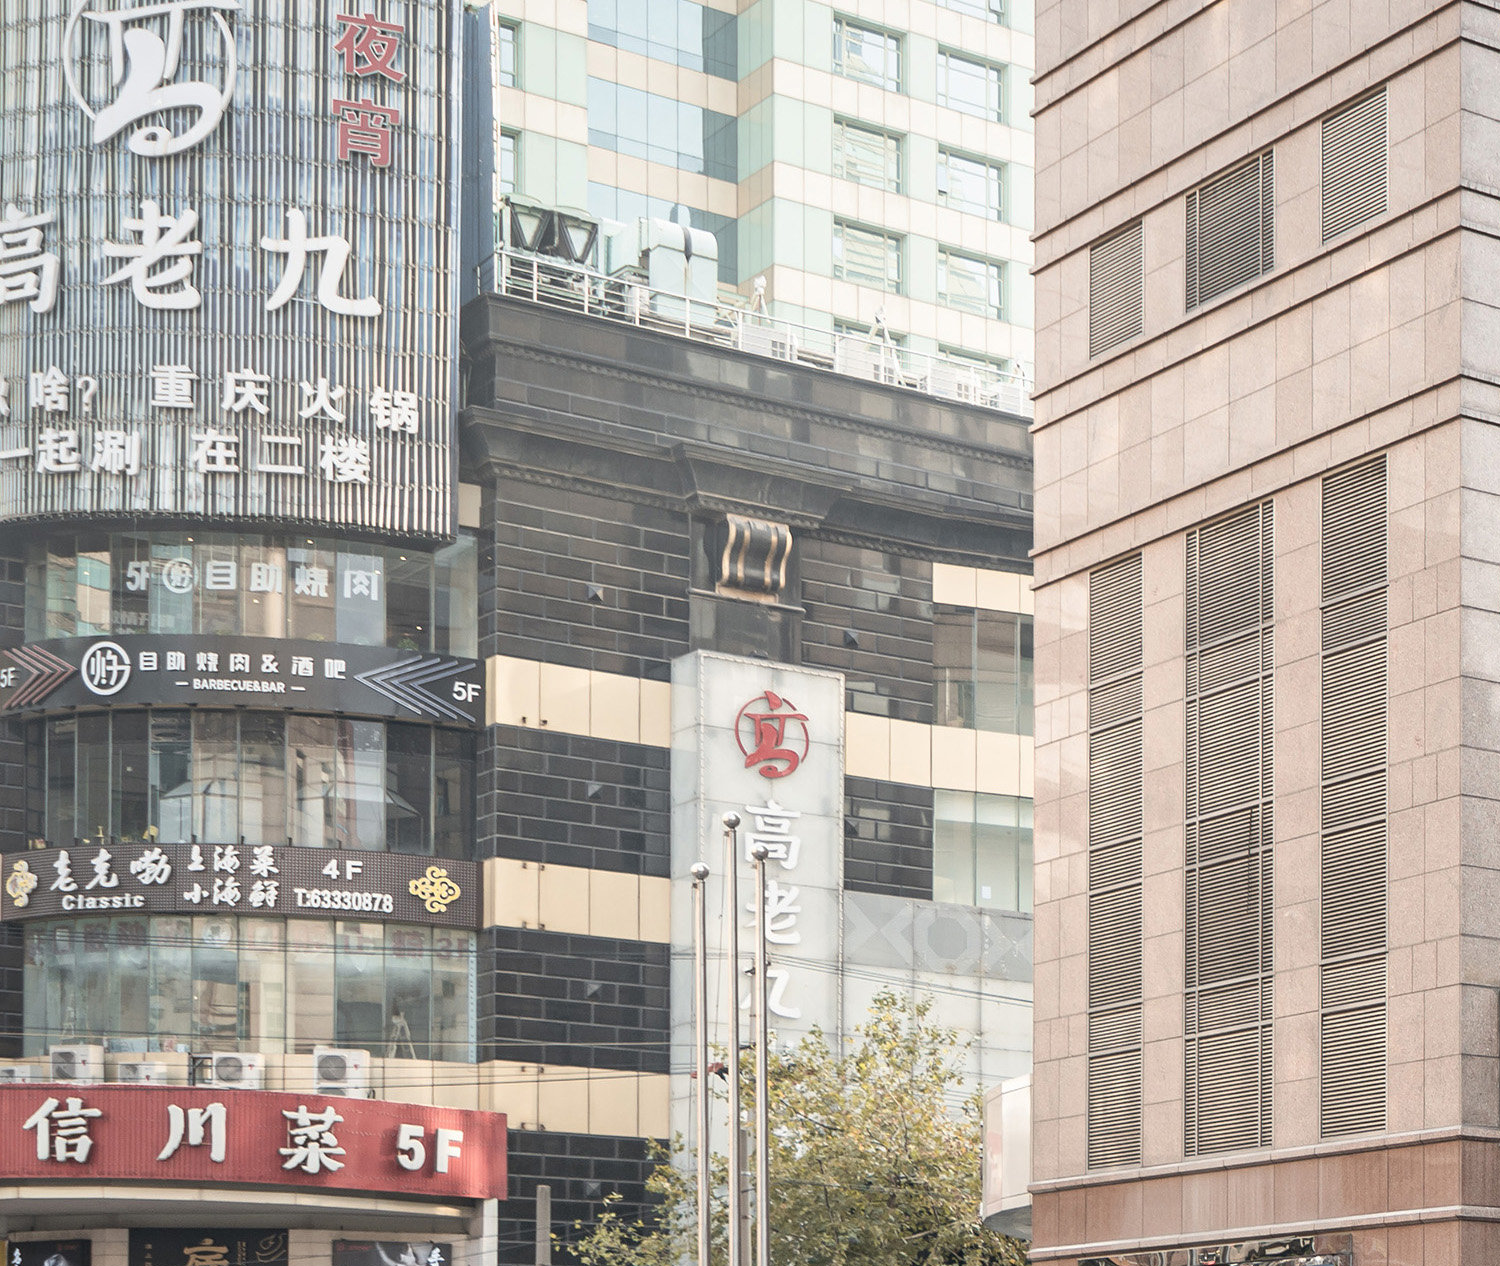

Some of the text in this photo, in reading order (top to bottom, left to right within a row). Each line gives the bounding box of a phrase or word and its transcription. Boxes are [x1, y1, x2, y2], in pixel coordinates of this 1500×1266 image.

[333, 13, 406, 168] 夜宵
[150, 364, 419, 434] 重庆火锅
[191, 428, 372, 485] 在二楼
[126, 560, 379, 601] 5F 自助烧肉
[139, 651, 347, 680] 自助烧肉&酒吧
[193, 677, 286, 695] BARBECUE&BAR
[451, 680, 482, 704] 5F
[186, 844, 281, 877] 上海菜
[322, 859, 365, 881] 4F
[62, 892, 146, 911] Classic
[183, 878, 280, 909] 小海鲜
[294, 887, 394, 914] T:63330878
[23, 1097, 465, 1175] 信川菜 5F
